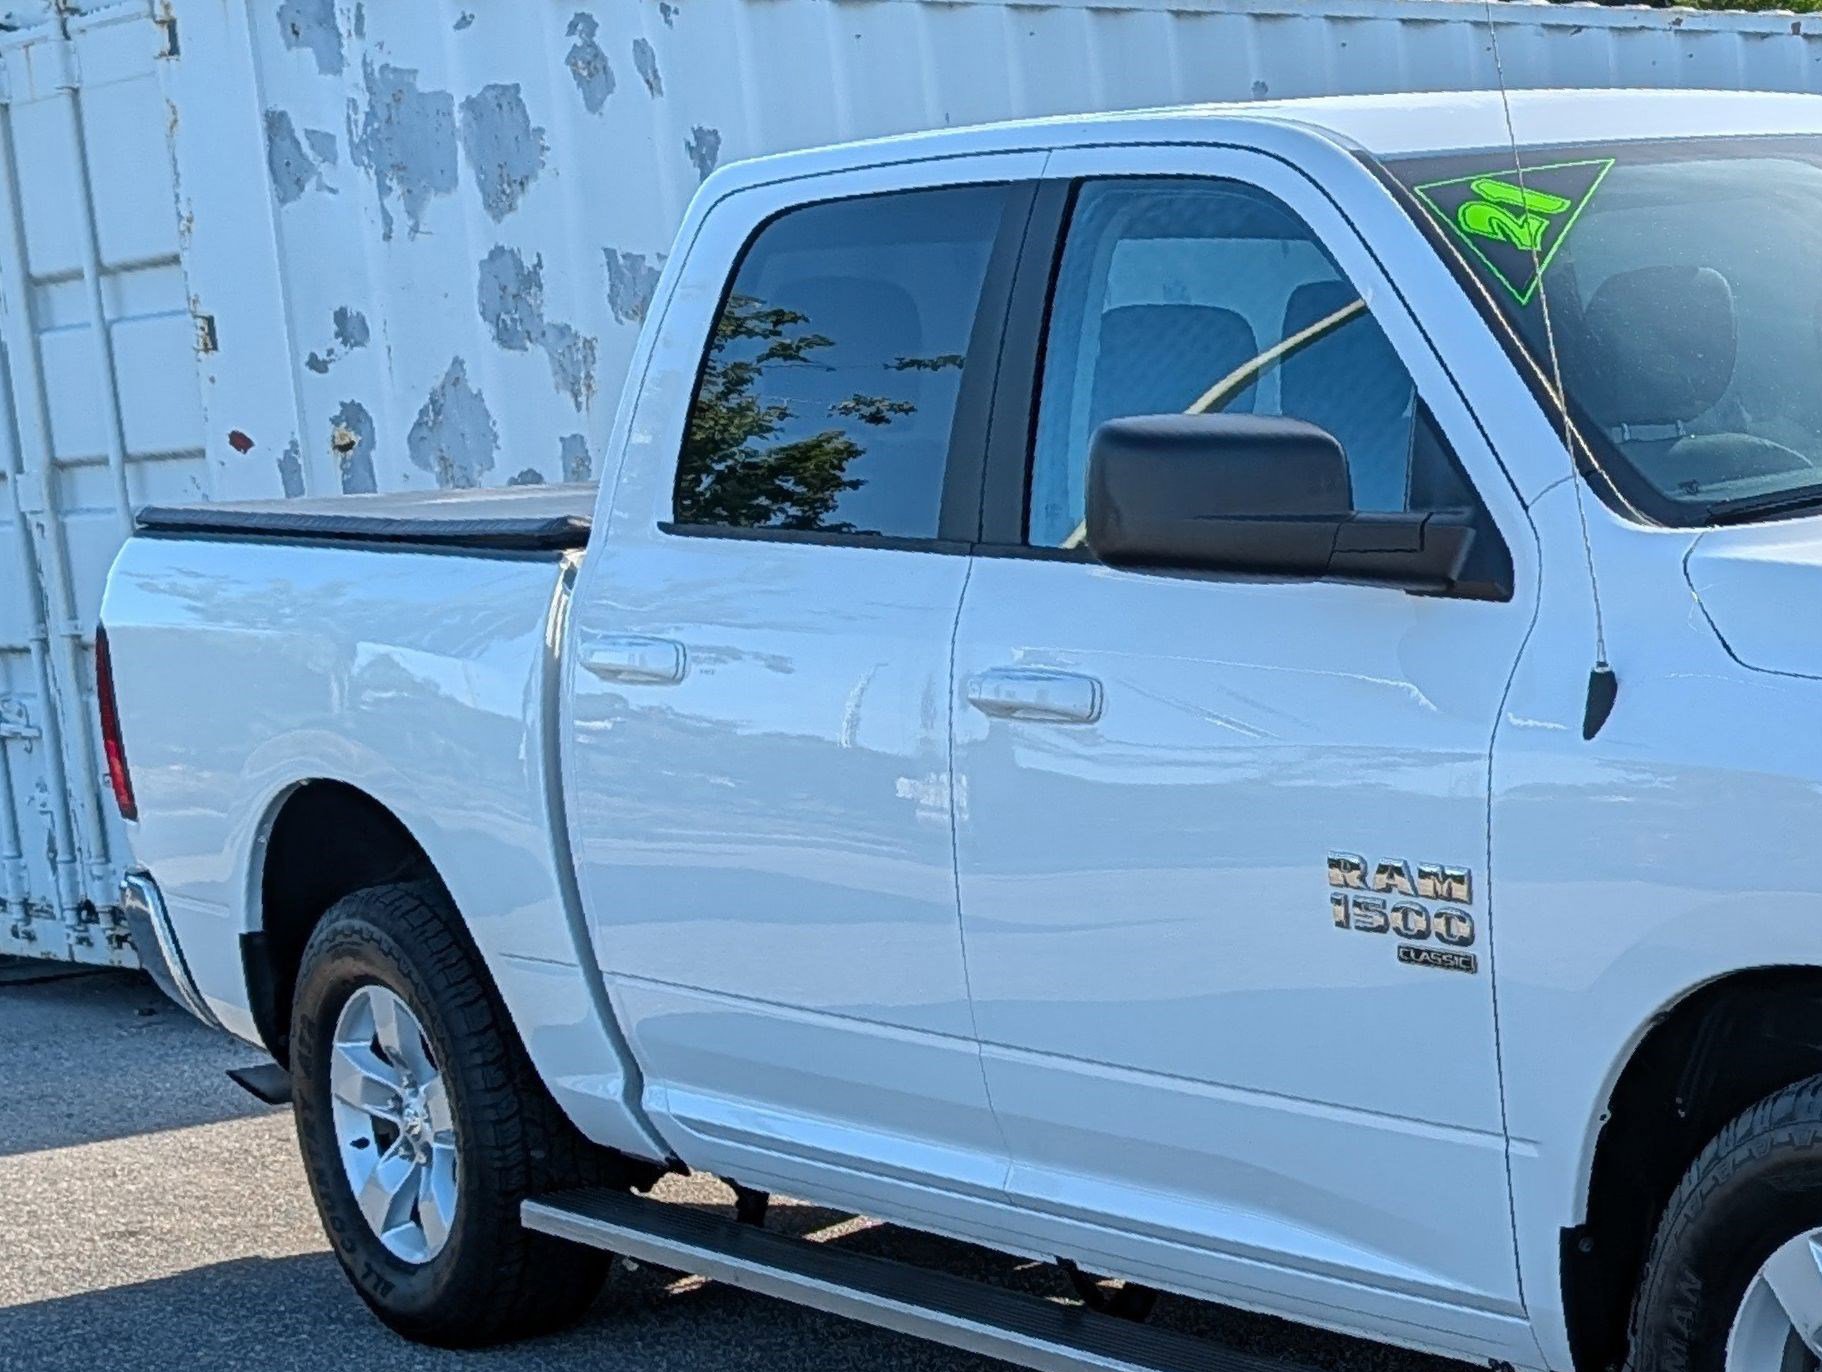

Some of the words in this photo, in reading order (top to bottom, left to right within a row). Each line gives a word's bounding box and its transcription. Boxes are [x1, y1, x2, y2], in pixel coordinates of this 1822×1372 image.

[1456, 177, 1571, 251] 21
[1328, 851, 1473, 904] RAM
[1330, 891, 1475, 947] 1500
[1400, 949, 1472, 970] CLASSIC
